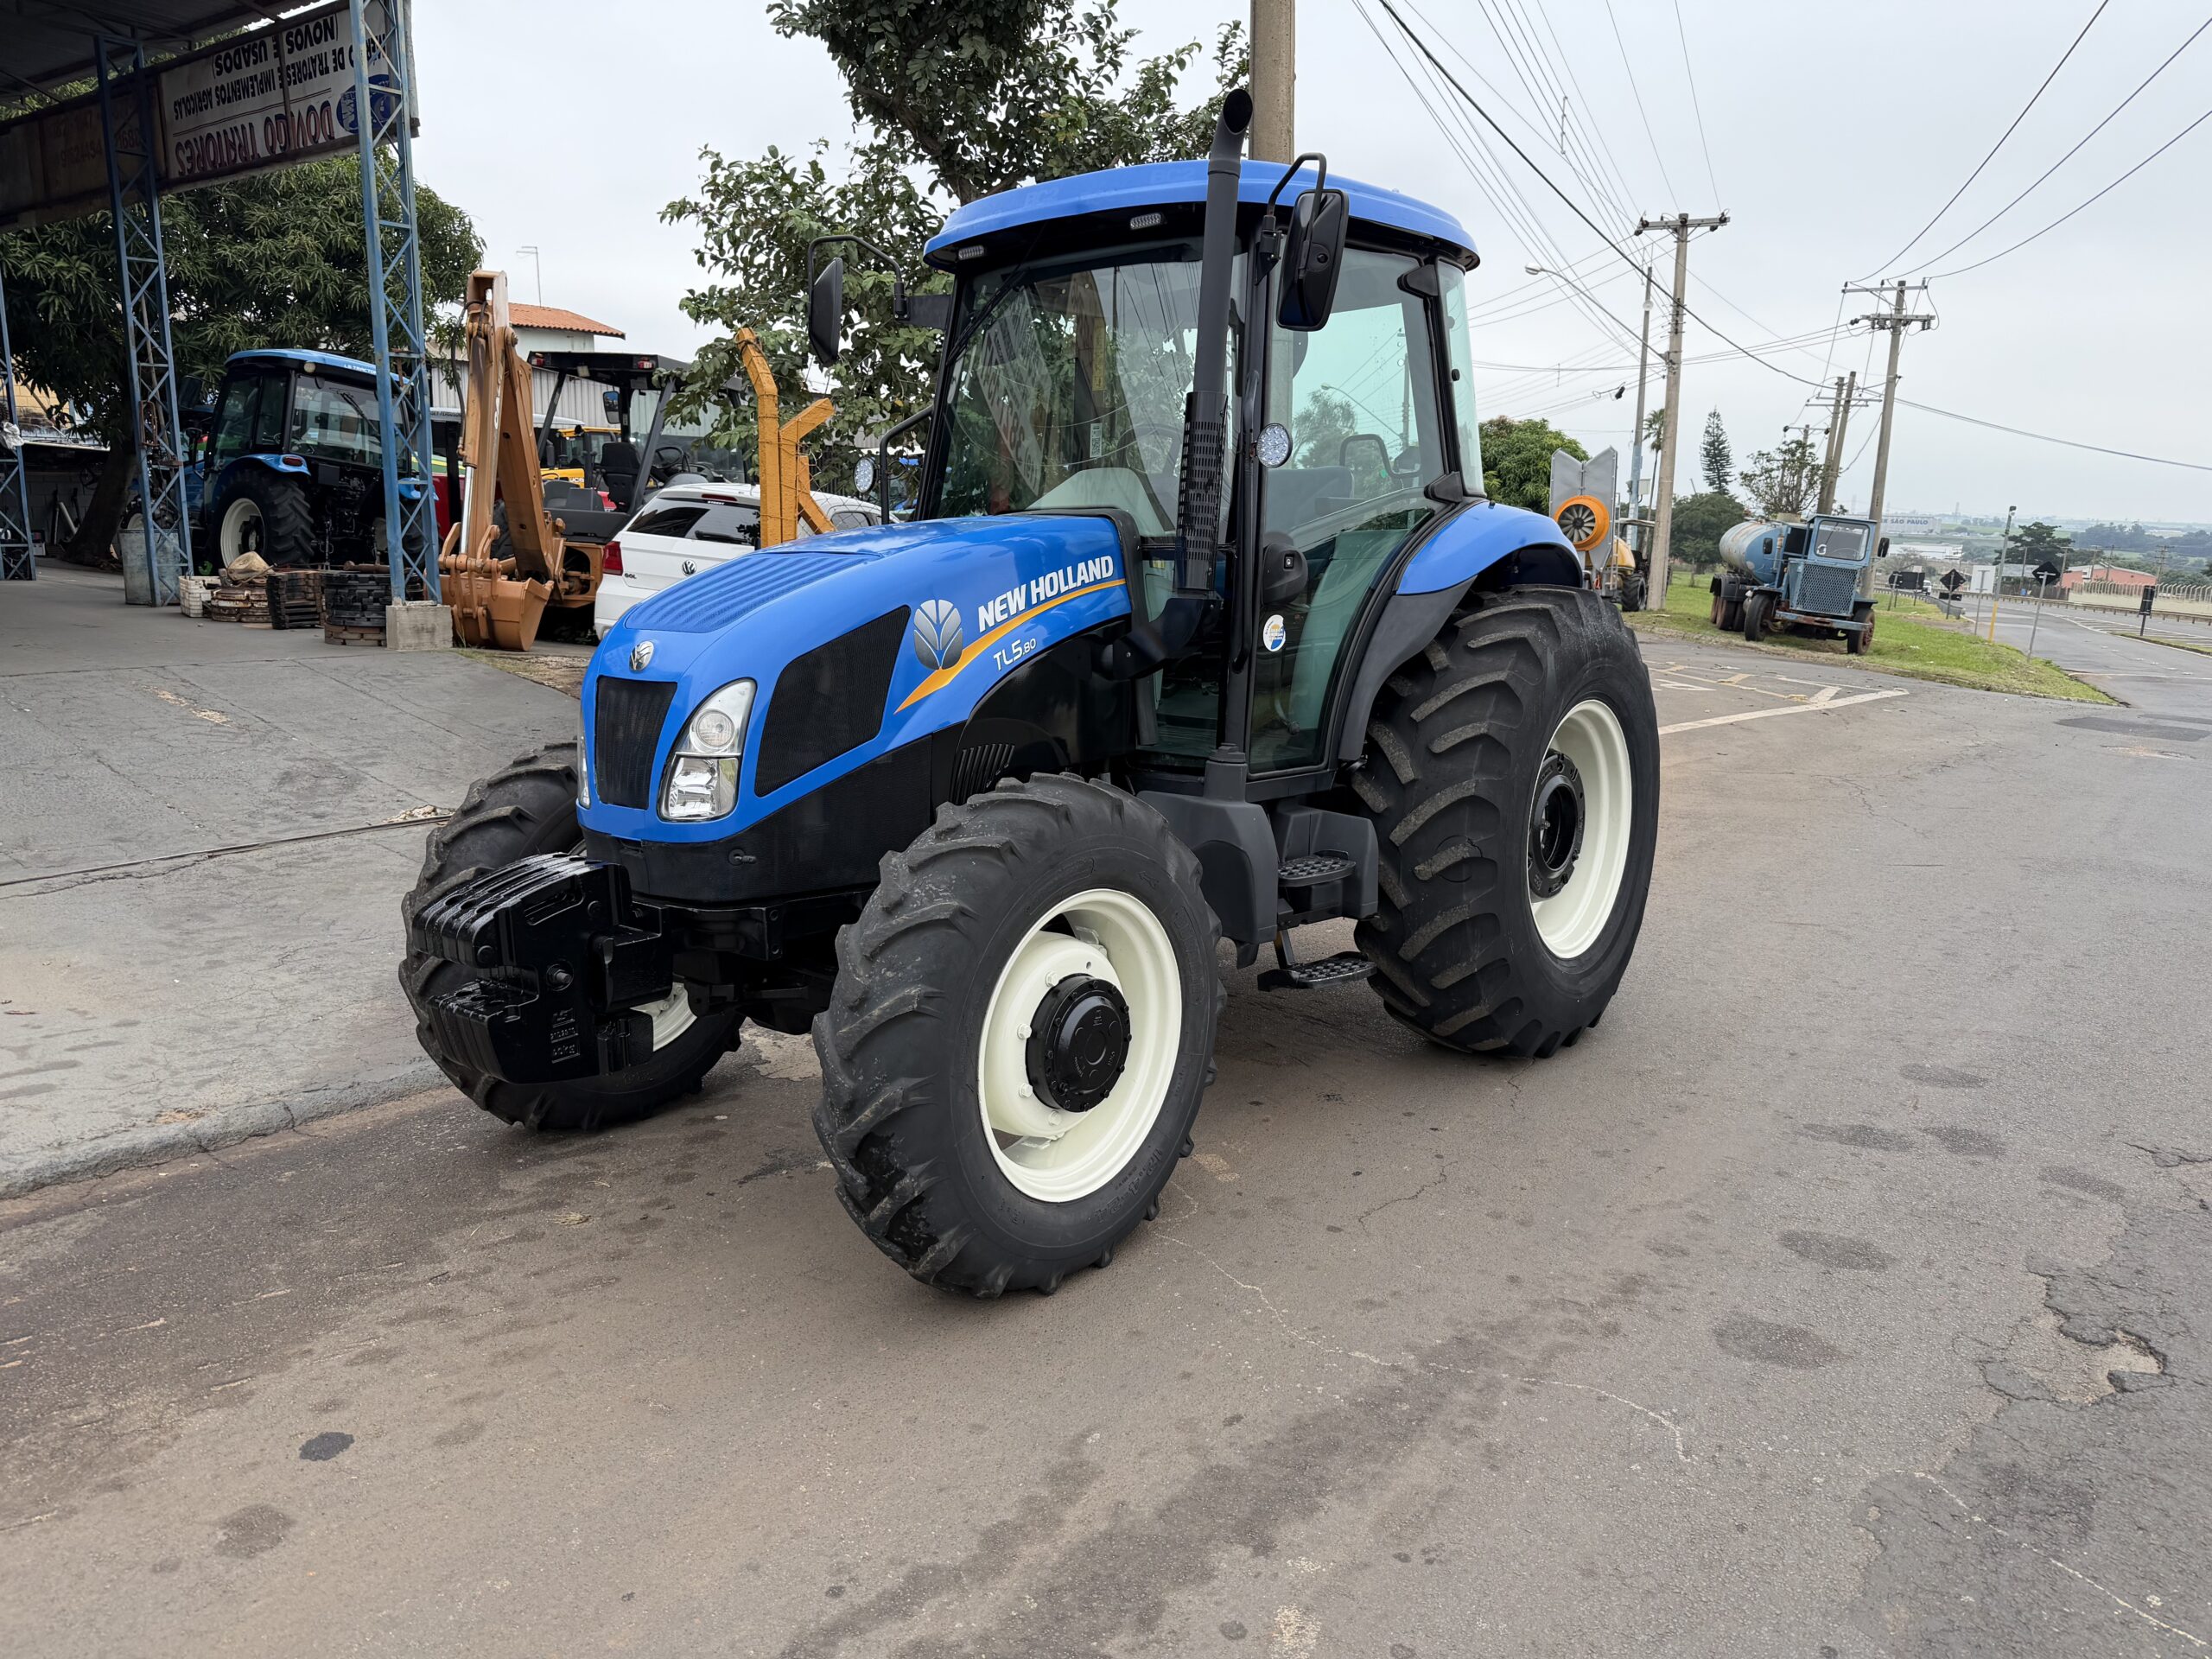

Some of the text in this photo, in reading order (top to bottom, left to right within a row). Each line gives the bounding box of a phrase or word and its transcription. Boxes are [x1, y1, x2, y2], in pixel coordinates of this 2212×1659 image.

[286, 51, 332, 87] TRATORES
[333, 47, 346, 72] DE
[174, 87, 213, 120] AGRÍCOLAS
[215, 68, 276, 106] IMPLEMENTOS
[175, 122, 261, 176] TRATORES
[978, 555, 1114, 633] NEW HOLLAND
